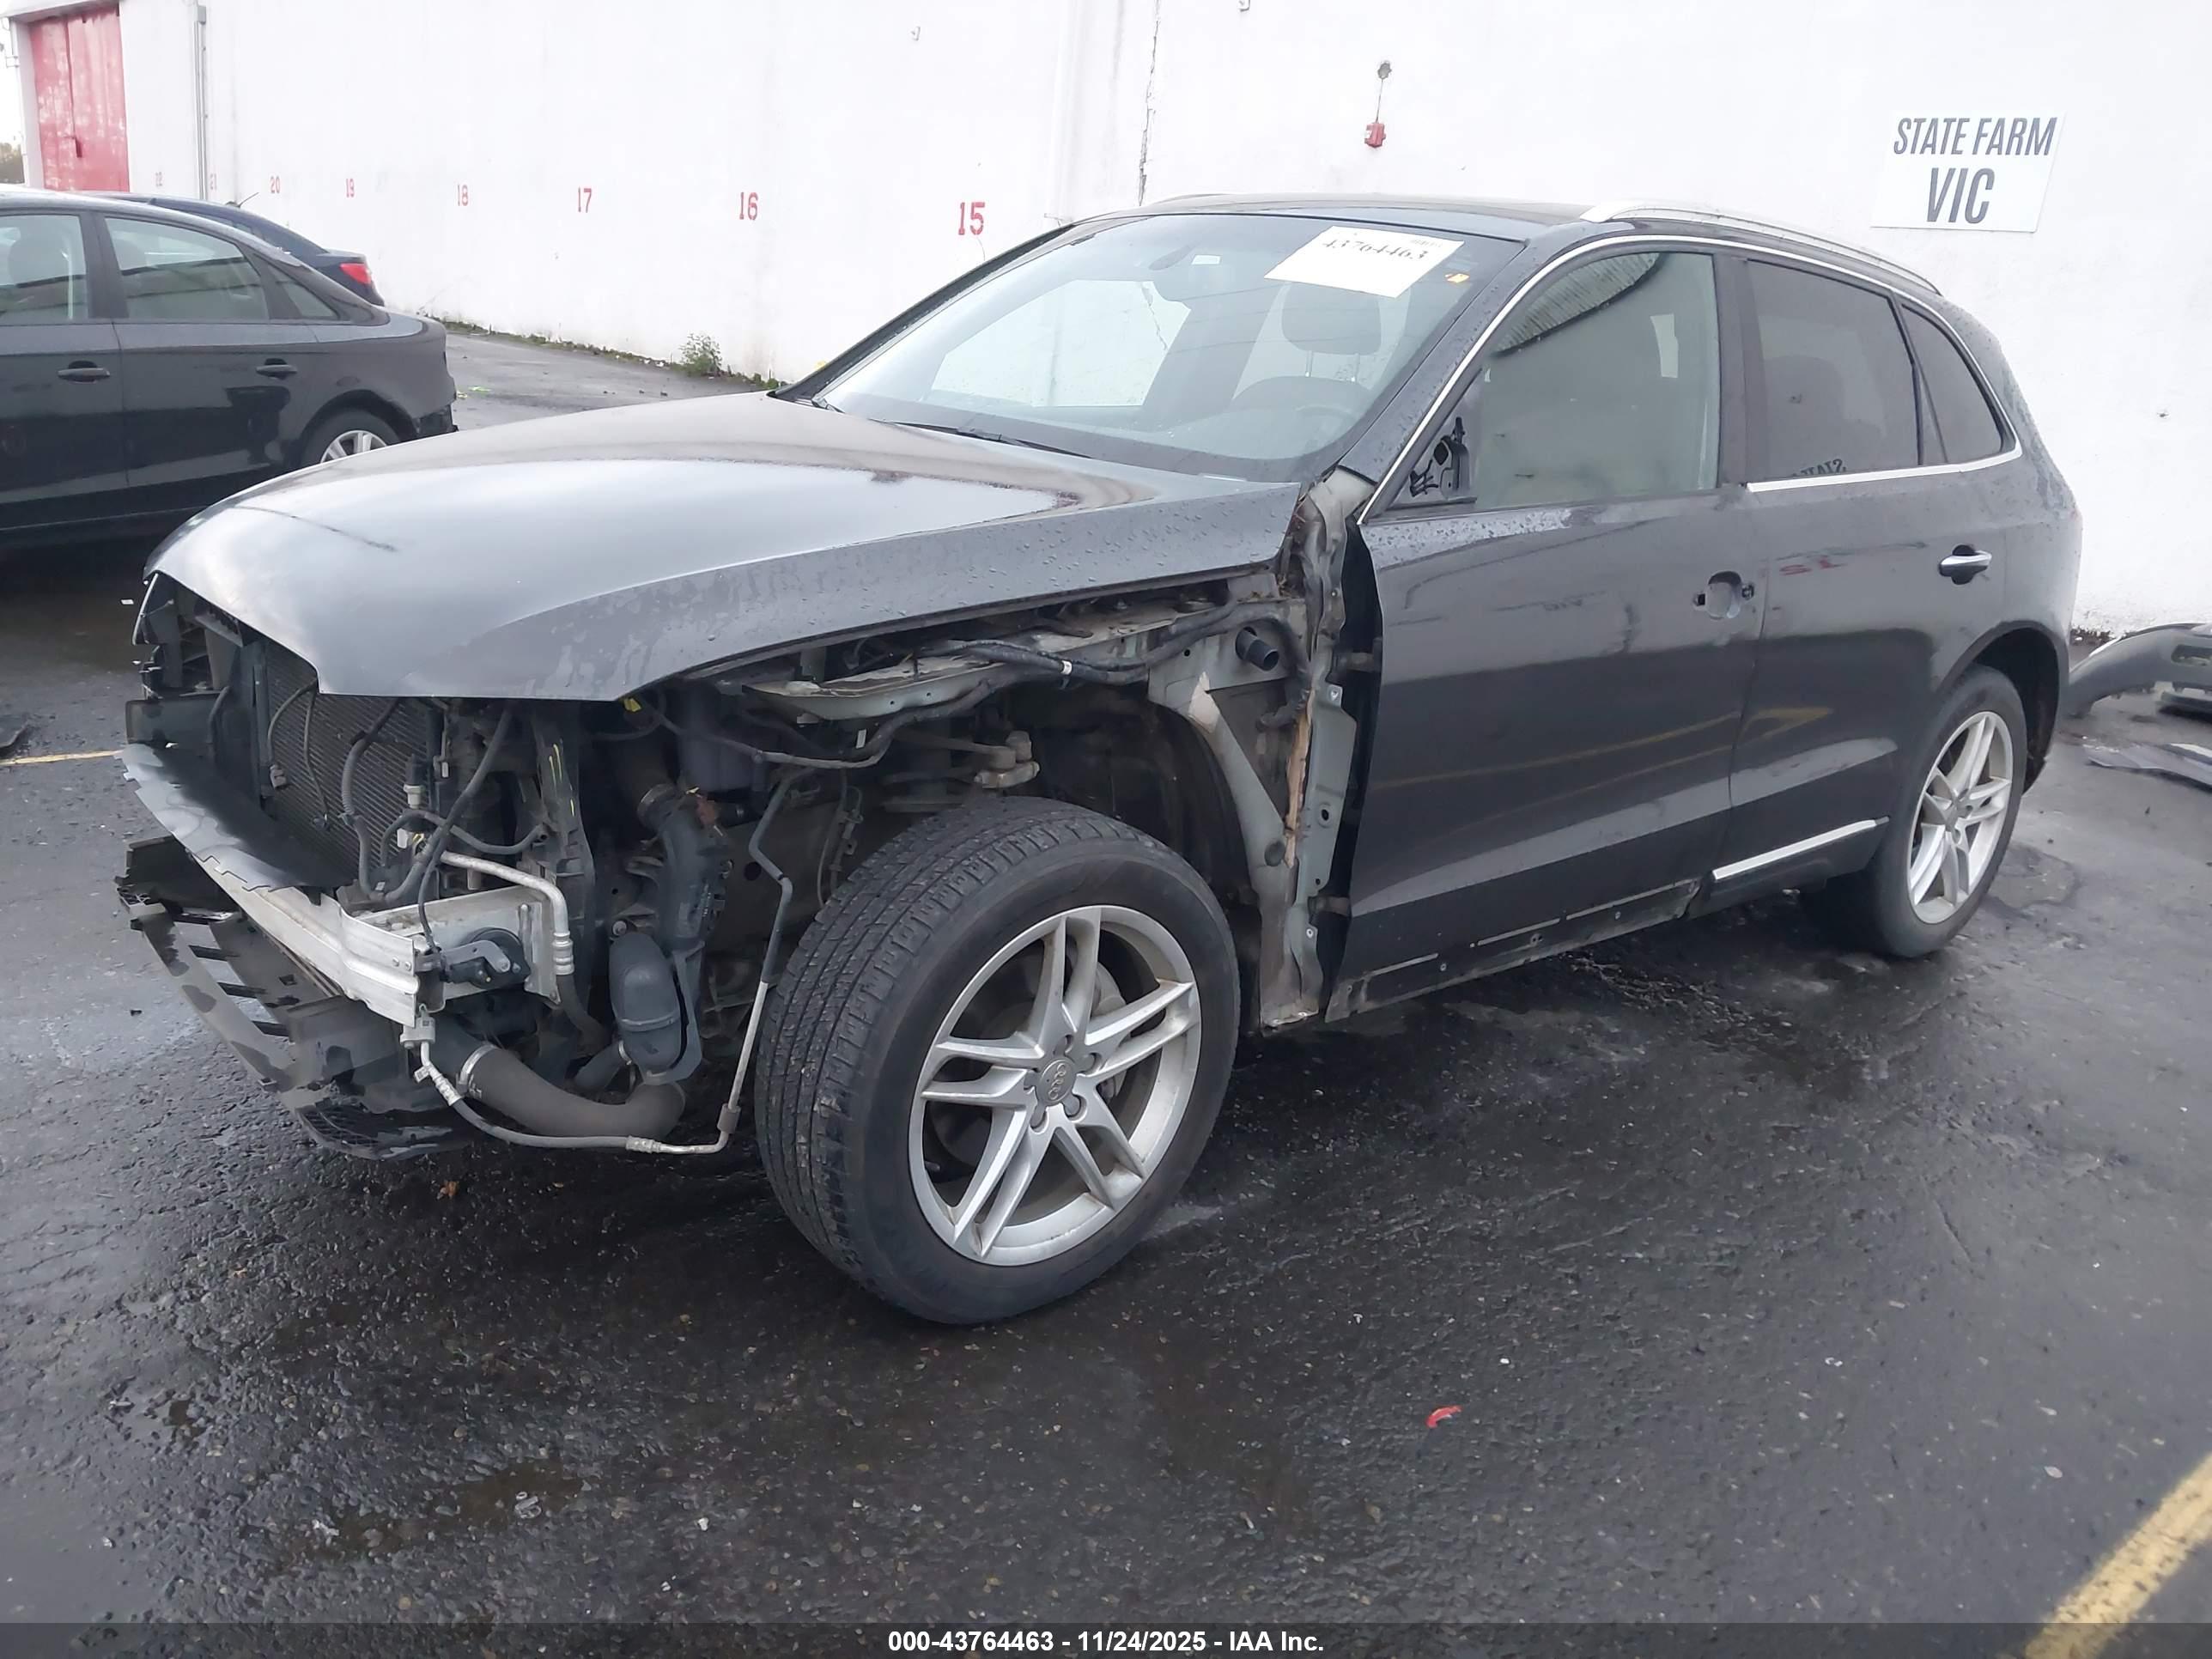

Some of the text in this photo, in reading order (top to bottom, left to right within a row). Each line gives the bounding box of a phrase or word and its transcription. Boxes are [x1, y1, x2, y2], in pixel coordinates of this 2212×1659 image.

[1893, 117, 2057, 156] STATE FARM
[270, 175, 281, 194] 20
[345, 178, 356, 198] 19
[457, 184, 469, 207] 18
[1926, 167, 1995, 223] VIC
[577, 186, 592, 213] 17
[738, 191, 759, 221] 16
[957, 201, 986, 236] 15
